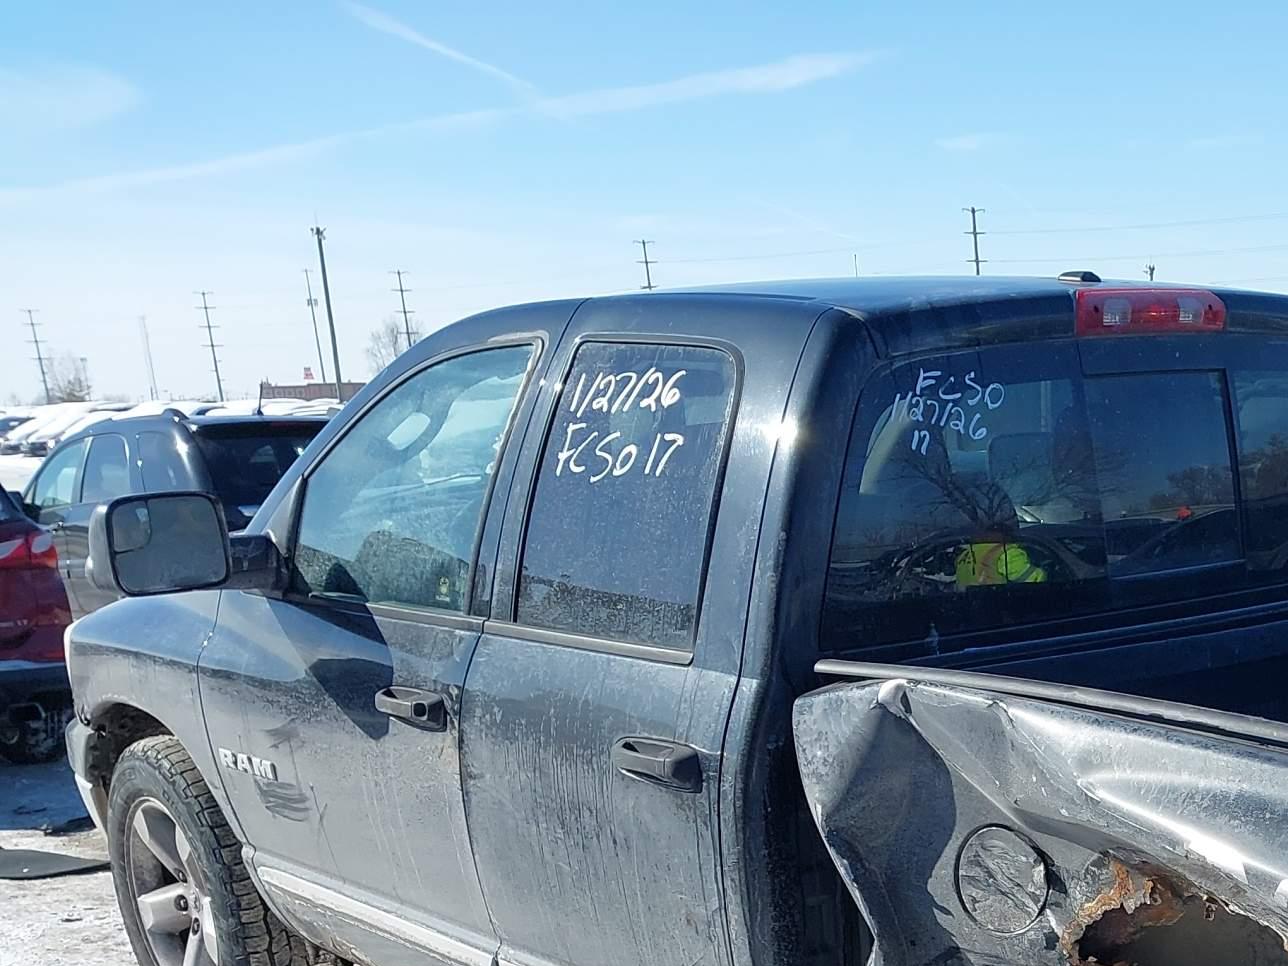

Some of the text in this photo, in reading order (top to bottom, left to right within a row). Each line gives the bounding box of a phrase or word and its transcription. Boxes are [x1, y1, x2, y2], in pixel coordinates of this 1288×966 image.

[570, 367, 686, 418] 1/27/26
[891, 392, 987, 440] 1/27/26
[644, 433, 685, 477] 17
[912, 430, 930, 455] 17
[218, 747, 278, 782] RAM
